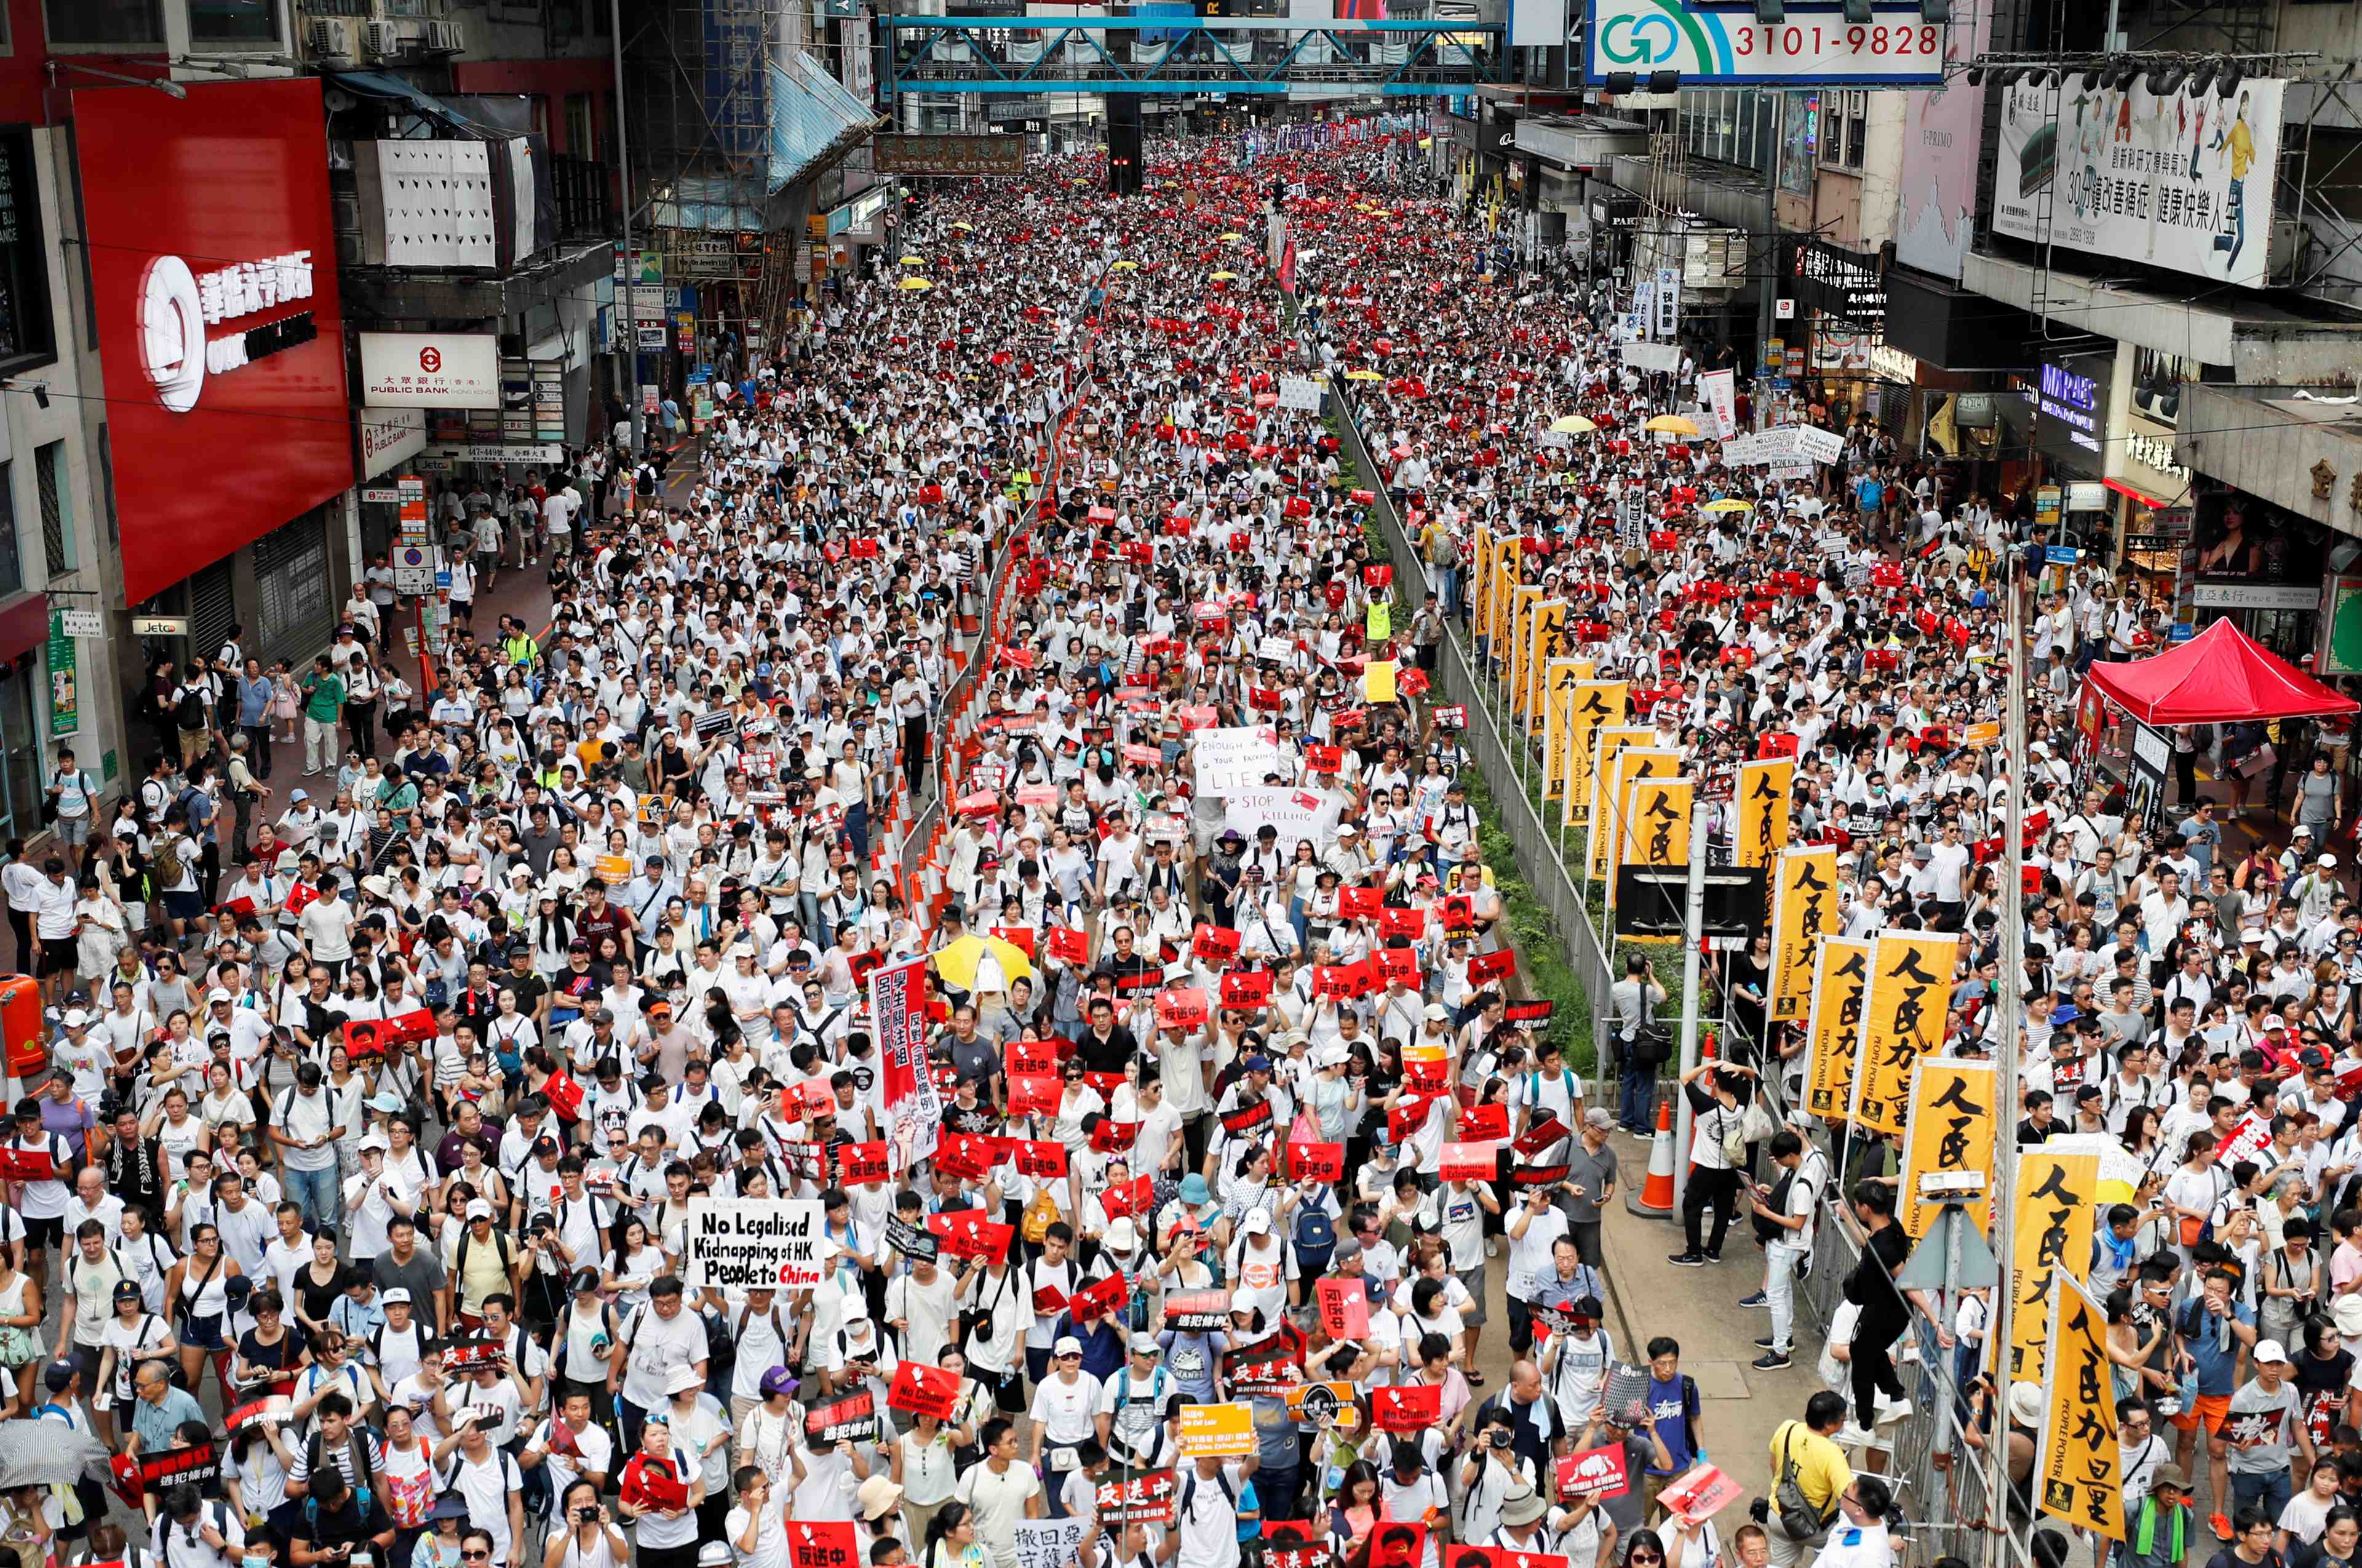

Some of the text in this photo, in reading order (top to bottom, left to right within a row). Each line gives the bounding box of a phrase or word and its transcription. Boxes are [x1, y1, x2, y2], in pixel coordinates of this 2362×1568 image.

[1735, 26, 1938, 57] 3101-9828
[1923, 129, 1953, 149] I-PRIMO
[375, 429, 408, 453] PUBLIC BANK
[1805, 433, 1814, 442] No
[420, 570, 426, 578] 7
[1201, 741, 1243, 752] ENOUGH
[1214, 756, 1234, 765] YOUR
[1242, 795, 1274, 808] STOP
[1262, 811, 1311, 822] KILLING
[1355, 902, 1375, 912] China
[1395, 923, 1416, 932] China
[1199, 940, 1232, 955] 反送中
[1377, 964, 1409, 977] 反送中
[1318, 982, 1351, 996] 反送中
[1781, 970, 1791, 996] POWER
[1227, 989, 1262, 1005] 反送中
[1164, 1006, 1199, 1022] 反送中
[1881, 947, 1946, 1128] 人民力量
[1013, 1059, 1049, 1073] 反送中
[1818, 1029, 1830, 1089] PEOPLE POWER
[1868, 1036, 1882, 1099] PEOPLE POWER
[1028, 1096, 1052, 1107] China
[849, 1161, 889, 1178] 反送中
[1022, 1158, 1059, 1173] 反送中
[1295, 1161, 1334, 1176] 反送中
[702, 1212, 810, 1240] No Legalised
[694, 1236, 813, 1266] Kidnapping of HK
[956, 1236, 998, 1254] No China
[704, 1260, 820, 1288] People to China
[1325, 1288, 1346, 1330] 反送中
[1177, 1314, 1227, 1327] 逃犯條例
[1233, 1361, 1299, 1383] 反送中
[1620, 1364, 1632, 1377] 69
[899, 1385, 945, 1404] No China
[895, 1396, 942, 1414] Extradition
[1383, 1409, 1430, 1420] No China
[2067, 1302, 2119, 1527] 人民力量
[823, 1420, 874, 1442] 逃犯條例
[2053, 1398, 2070, 1478] PEOPLE POWER
[160, 1466, 216, 1487] 逃犯條例
[1096, 1478, 1172, 1507] 反送中
[798, 1546, 847, 1567] 反送中
